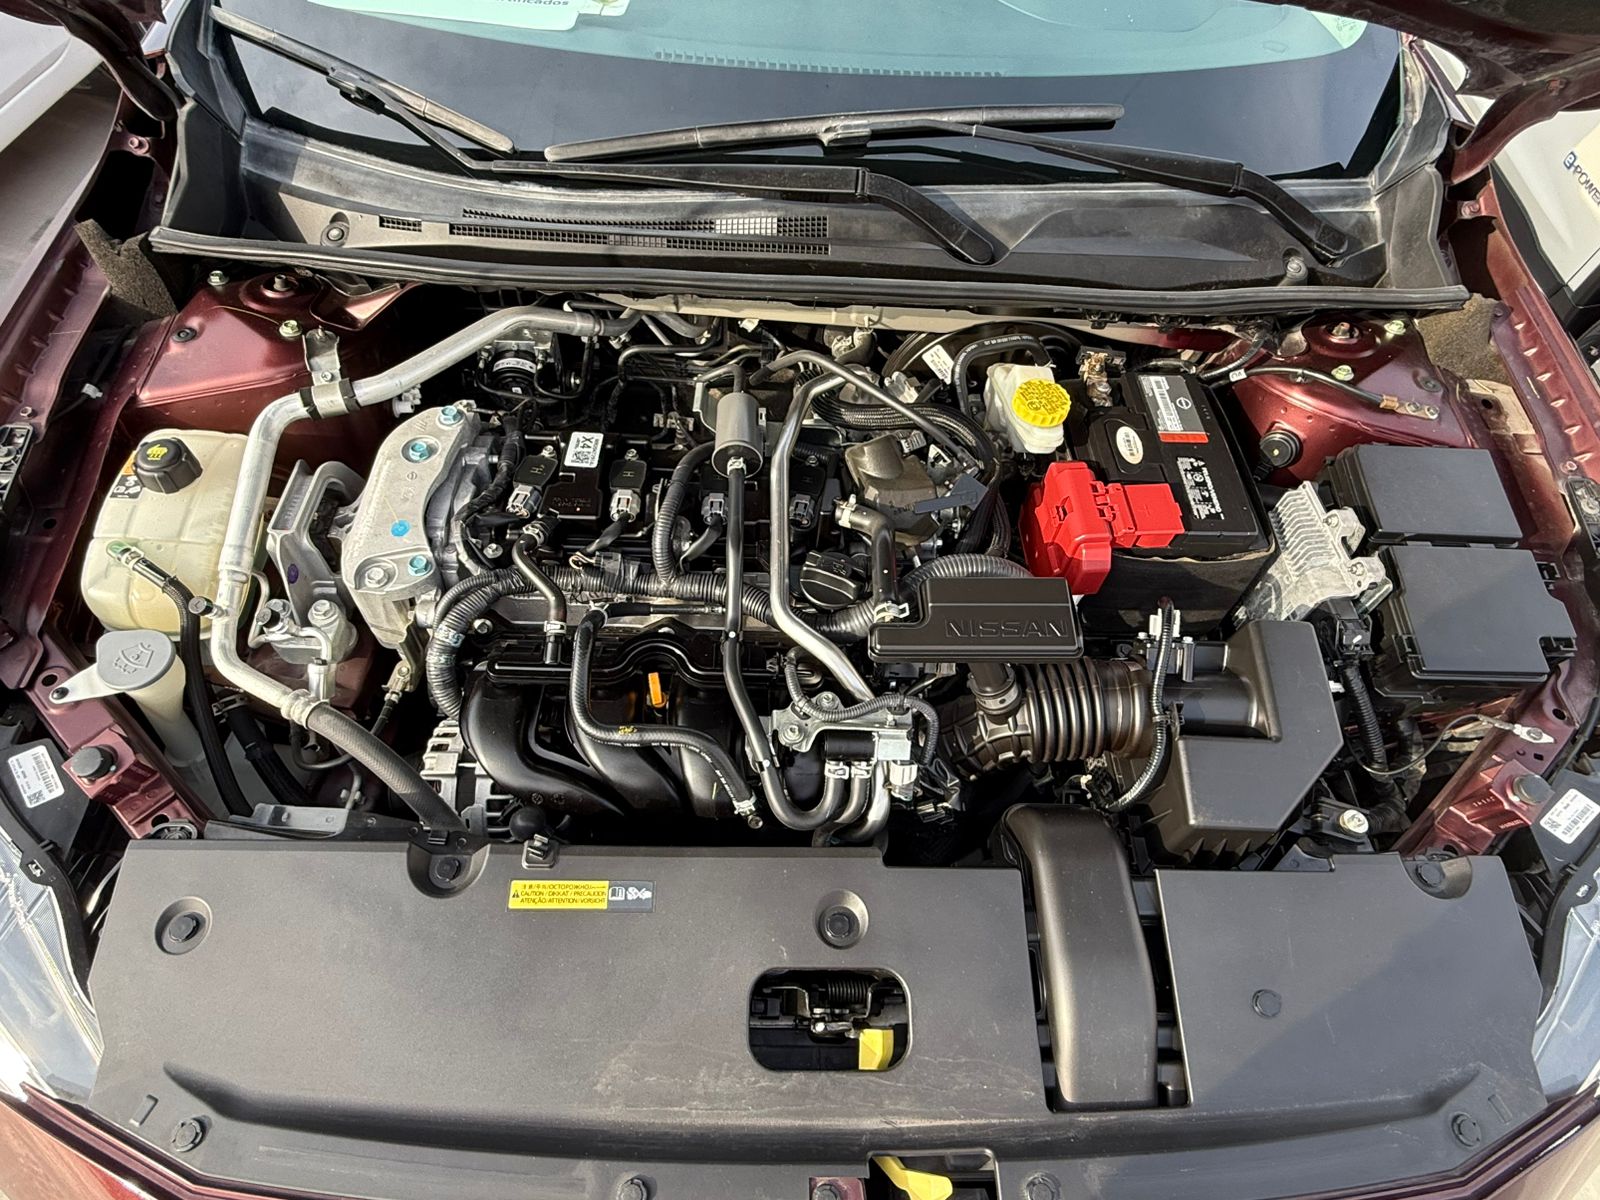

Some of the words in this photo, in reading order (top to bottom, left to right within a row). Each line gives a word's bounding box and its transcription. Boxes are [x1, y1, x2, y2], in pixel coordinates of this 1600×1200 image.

[1563, 151, 1600, 206] e-POWE
[580, 435, 594, 450] X4
[945, 620, 1069, 638] NISSAN
